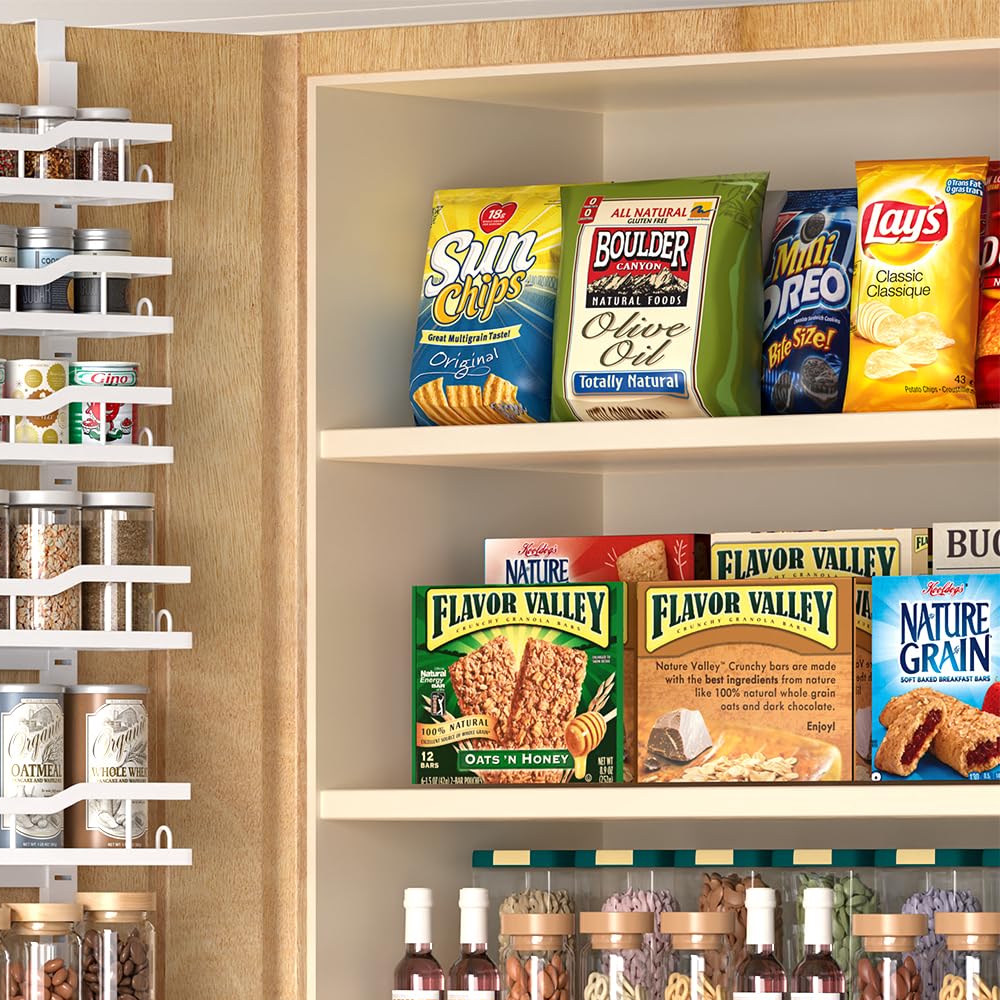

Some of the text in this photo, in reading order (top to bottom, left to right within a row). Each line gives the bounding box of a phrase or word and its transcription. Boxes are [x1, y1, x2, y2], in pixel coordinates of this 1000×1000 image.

[970, 180, 981, 188] Fat
[611, 208, 687, 218] ALL NATURAL
[864, 202, 944, 245] Lay's
[593, 230, 690, 269] BOULDER
[772, 233, 836, 281] Mini
[424, 230, 538, 298] Sun
[616, 262, 662, 271] CANYON
[876, 270, 924, 283] Classic
[433, 271, 527, 325] Chips
[592, 295, 681, 306] NATURAL FOODS
[866, 284, 931, 300] Classique
[581, 311, 690, 339] Olive
[428, 330, 511, 344] Great Multigrain Taste!
[600, 339, 671, 367] Oil
[768, 326, 838, 370] Bite Size!
[430, 347, 499, 379] Original
[90, 372, 128, 384] Gino
[579, 374, 679, 392] Totally Natural
[954, 375, 966, 384] 43
[506, 558, 569, 583] NATURE
[717, 546, 896, 580] FLAVOR VALLEY
[432, 590, 606, 639] FLAVOR VALLEY
[651, 590, 835, 640] FLAVOR VALLEY
[900, 602, 990, 644] NATURE
[456, 616, 581, 633] CRUNCHY GRANOLA BARS
[676, 616, 808, 634] CRUNCHY GRANOLA BARS
[900, 635, 990, 674] GRAIN
[656, 661, 688, 670] Nature
[728, 661, 766, 673] Crunchy
[770, 661, 789, 670] bars
[811, 661, 836, 670] made
[665, 674, 836, 686] with the best ingredients from nature
[696, 688, 836, 700] like 100% natural whole grain
[742, 702, 760, 710] and
[764, 702, 784, 710] dark
[788, 702, 835, 710] chocolate.
[421, 718, 488, 736] 100% NATURAL
[807, 721, 836, 733] Enjoy!
[422, 752, 434, 762] 12
[465, 753, 500, 764] OATS
[522, 752, 569, 764] HONEY
